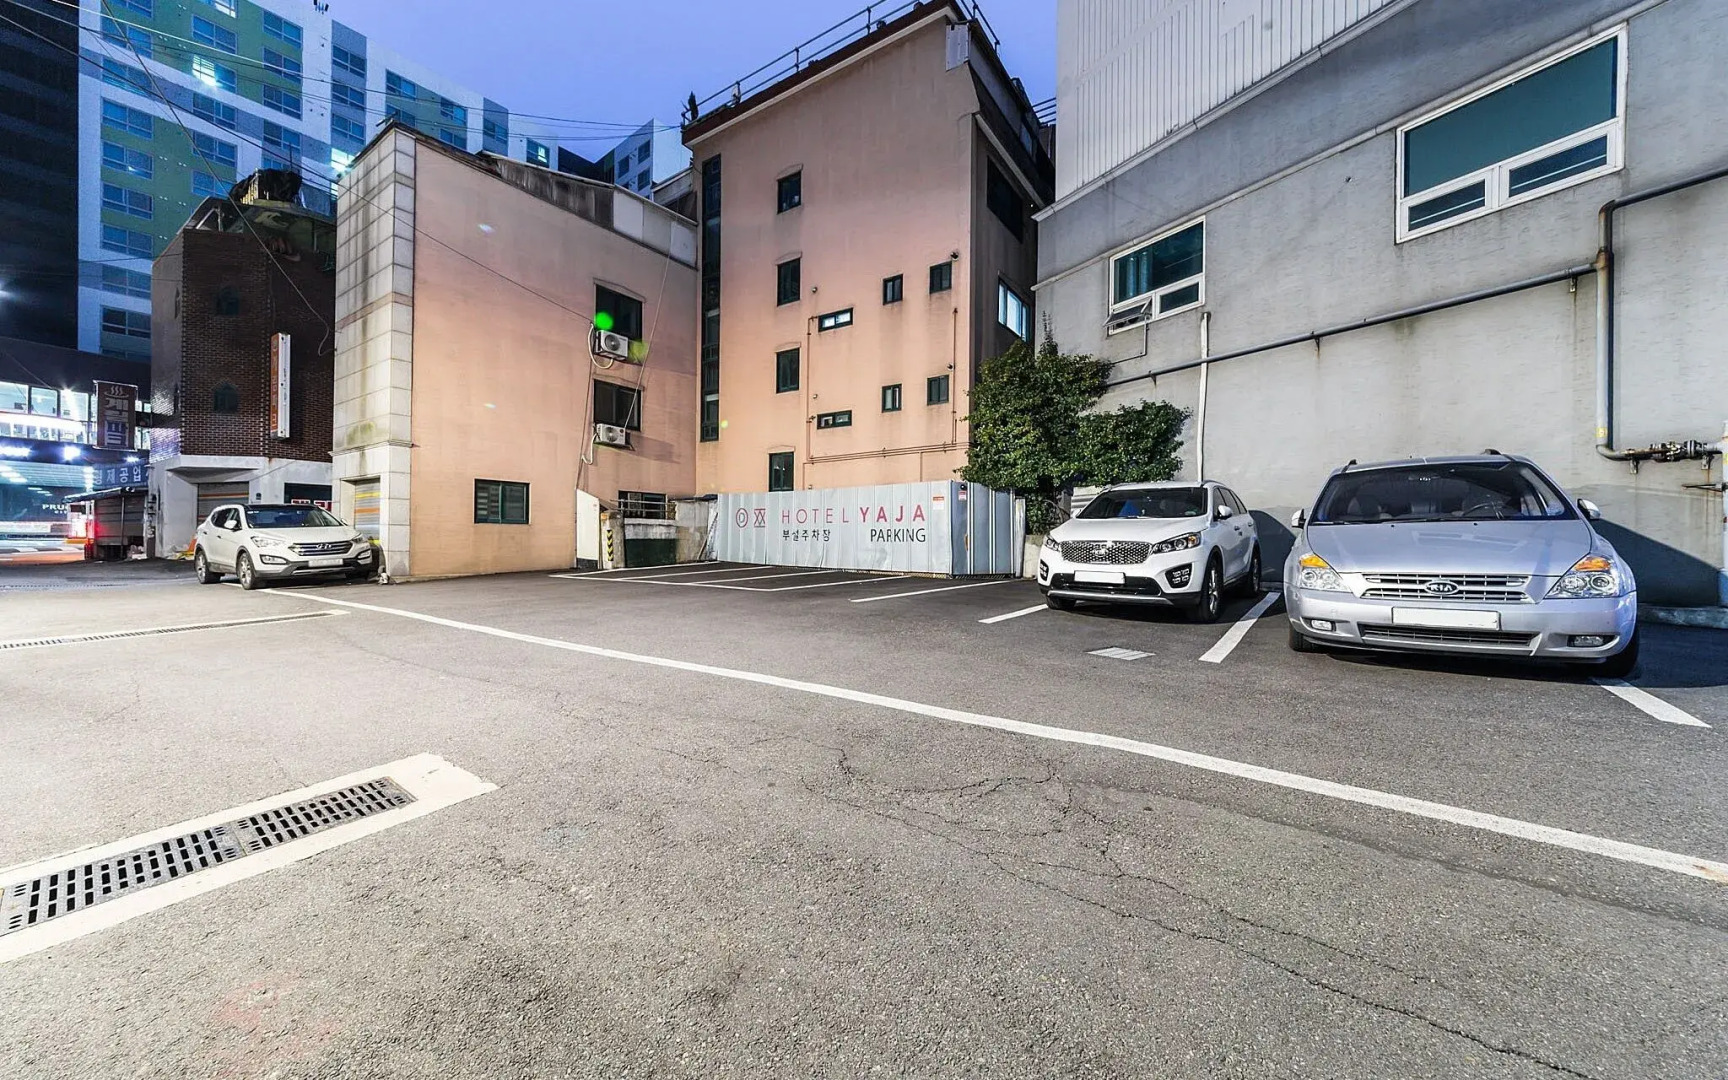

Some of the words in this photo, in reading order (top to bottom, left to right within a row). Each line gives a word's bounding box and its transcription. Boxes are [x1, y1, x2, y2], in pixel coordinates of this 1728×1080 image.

[782, 507, 850, 524] HOTEL
[860, 504, 925, 523] YAJA
[782, 529, 831, 542] 부설주차장
[870, 528, 926, 542] PARKING
